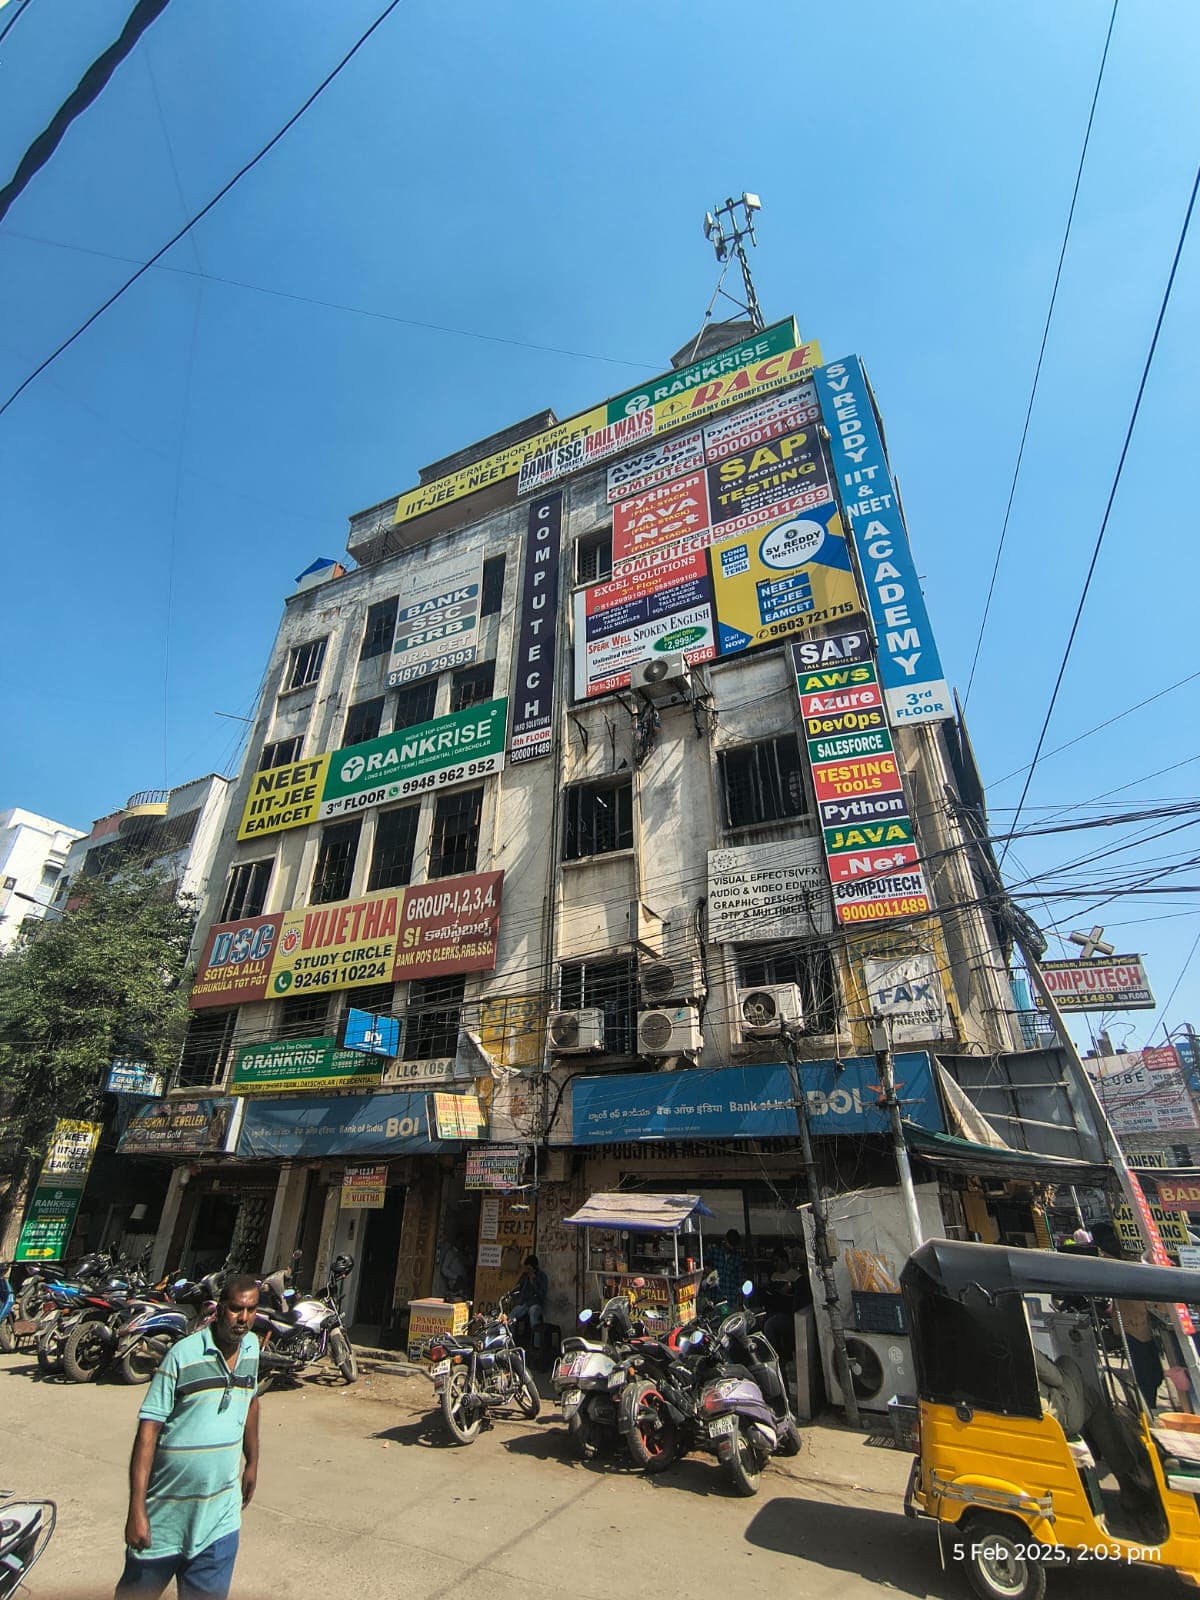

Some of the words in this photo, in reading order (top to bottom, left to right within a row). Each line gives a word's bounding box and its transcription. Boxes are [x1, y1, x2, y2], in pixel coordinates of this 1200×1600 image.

[654, 340, 770, 401] RANKRISE
[681, 402, 719, 422] ACADEMY
[731, 379, 783, 402] COMPETITIVE
[707, 407, 774, 438] Dynamics
[778, 390, 812, 408] CRM
[520, 453, 554, 482] BANK
[557, 439, 582, 466] SSC
[585, 407, 654, 454] RAILWAYS
[707, 407, 819, 460] 9000011489
[423, 479, 451, 497] LONG
[454, 464, 483, 481] TERM
[495, 442, 532, 464] SHORT
[536, 426, 567, 446] TERM
[611, 452, 657, 478] AWS
[662, 434, 700, 455] Azure
[720, 433, 807, 482] SAP
[748, 453, 812, 480] MODULES)
[405, 485, 456, 516] IIT-JEE
[468, 462, 510, 489] NEET
[523, 425, 592, 462] EAMCET
[608, 456, 703, 500] COMPUTECH
[844, 465, 879, 486] IIT
[620, 477, 700, 513] Python
[717, 462, 817, 505] TESTING
[857, 485, 875, 497] &
[623, 498, 699, 533] JAVA
[714, 490, 828, 537] 9000011489
[846, 494, 892, 519] NEET
[722, 547, 745, 558] LONG
[765, 545, 781, 556] SV
[783, 530, 822, 550] REDDY
[771, 540, 819, 560] INSTITUTE
[612, 533, 712, 578] COMPUTECH
[724, 552, 747, 564] TERM
[593, 580, 630, 598] EXCEL
[632, 554, 697, 585] SOLUTIONS
[725, 564, 748, 575] TERM
[636, 576, 663, 590] Floor
[761, 579, 795, 597] NEET
[407, 587, 470, 618] BANK
[763, 590, 804, 609] IIT-JEE
[863, 519, 922, 677] ACADEMY
[411, 606, 462, 631] SSC
[524, 505, 551, 719] COMPUTECH
[765, 601, 811, 622] EAMCET
[769, 617, 805, 636] 9603
[806, 609, 828, 624] 721
[830, 601, 854, 616] 715
[406, 621, 464, 648] RRB
[633, 621, 668, 642] SPOKEN
[670, 608, 710, 627] ENGLISH
[724, 633, 739, 642] Call
[725, 638, 746, 649] NOW
[396, 649, 431, 667] NRA
[436, 634, 472, 654] CET
[622, 645, 647, 658] Practice
[800, 635, 861, 665] SAP
[389, 663, 427, 686] 81870
[431, 649, 473, 672] 29393
[805, 668, 870, 691] AWS
[808, 690, 875, 713] Azure
[906, 690, 933, 706] 3rd
[896, 703, 945, 718] FLOOR
[808, 712, 881, 735] DevOps
[366, 718, 493, 773] RANKRISE
[525, 729, 551, 743] FLOOR
[817, 734, 884, 758] SALESFORCE
[511, 741, 551, 761] 9000011489
[255, 760, 323, 796] NEET
[816, 760, 895, 784] TESTING
[326, 801, 342, 815] 3rd
[344, 789, 386, 811] FLOOR
[402, 775, 436, 794] 9948
[438, 768, 464, 783] 962
[468, 758, 495, 776] 952
[834, 777, 882, 794] TOOLS
[249, 784, 318, 816] IIT-JEE
[824, 798, 904, 821] Python
[244, 805, 313, 834] EAMCET
[831, 824, 908, 849] JAVA
[840, 852, 907, 876] .Net
[709, 888, 741, 899] AUDIO
[752, 883, 783, 894] VIDEO
[785, 878, 827, 890] EDITING
[713, 875, 747, 886] VISUAL
[836, 875, 922, 899] COMPUTECH
[713, 898, 760, 910] GRAPHIC
[842, 898, 927, 921] 9000011489
[301, 896, 398, 951] VIJETHA
[208, 923, 276, 968] DSC
[402, 926, 421, 948] SI
[294, 952, 339, 971] STUDY
[342, 944, 393, 963] CIRCLE
[395, 952, 416, 967] BANK
[203, 966, 240, 981] SGT(SA
[241, 960, 265, 976] ALL)
[294, 961, 386, 989] 9246110224
[1035, 966, 1142, 992] OMPUTECH
[877, 983, 934, 1005] FAX
[1129, 992, 1149, 1000] FLOOR
[253, 1049, 326, 1068] RANKRISE
[730, 1101, 757, 1112] Bank
[807, 1087, 863, 1116] BOI
[150, 1131, 166, 1139] Gram
[167, 1129, 182, 1139] Gold
[385, 1117, 420, 1138] BOI
[34, 1199, 77, 1208] RANKRISE
[641, 1289, 668, 1301] STALL
[416, 1317, 448, 1326] PANDAY
